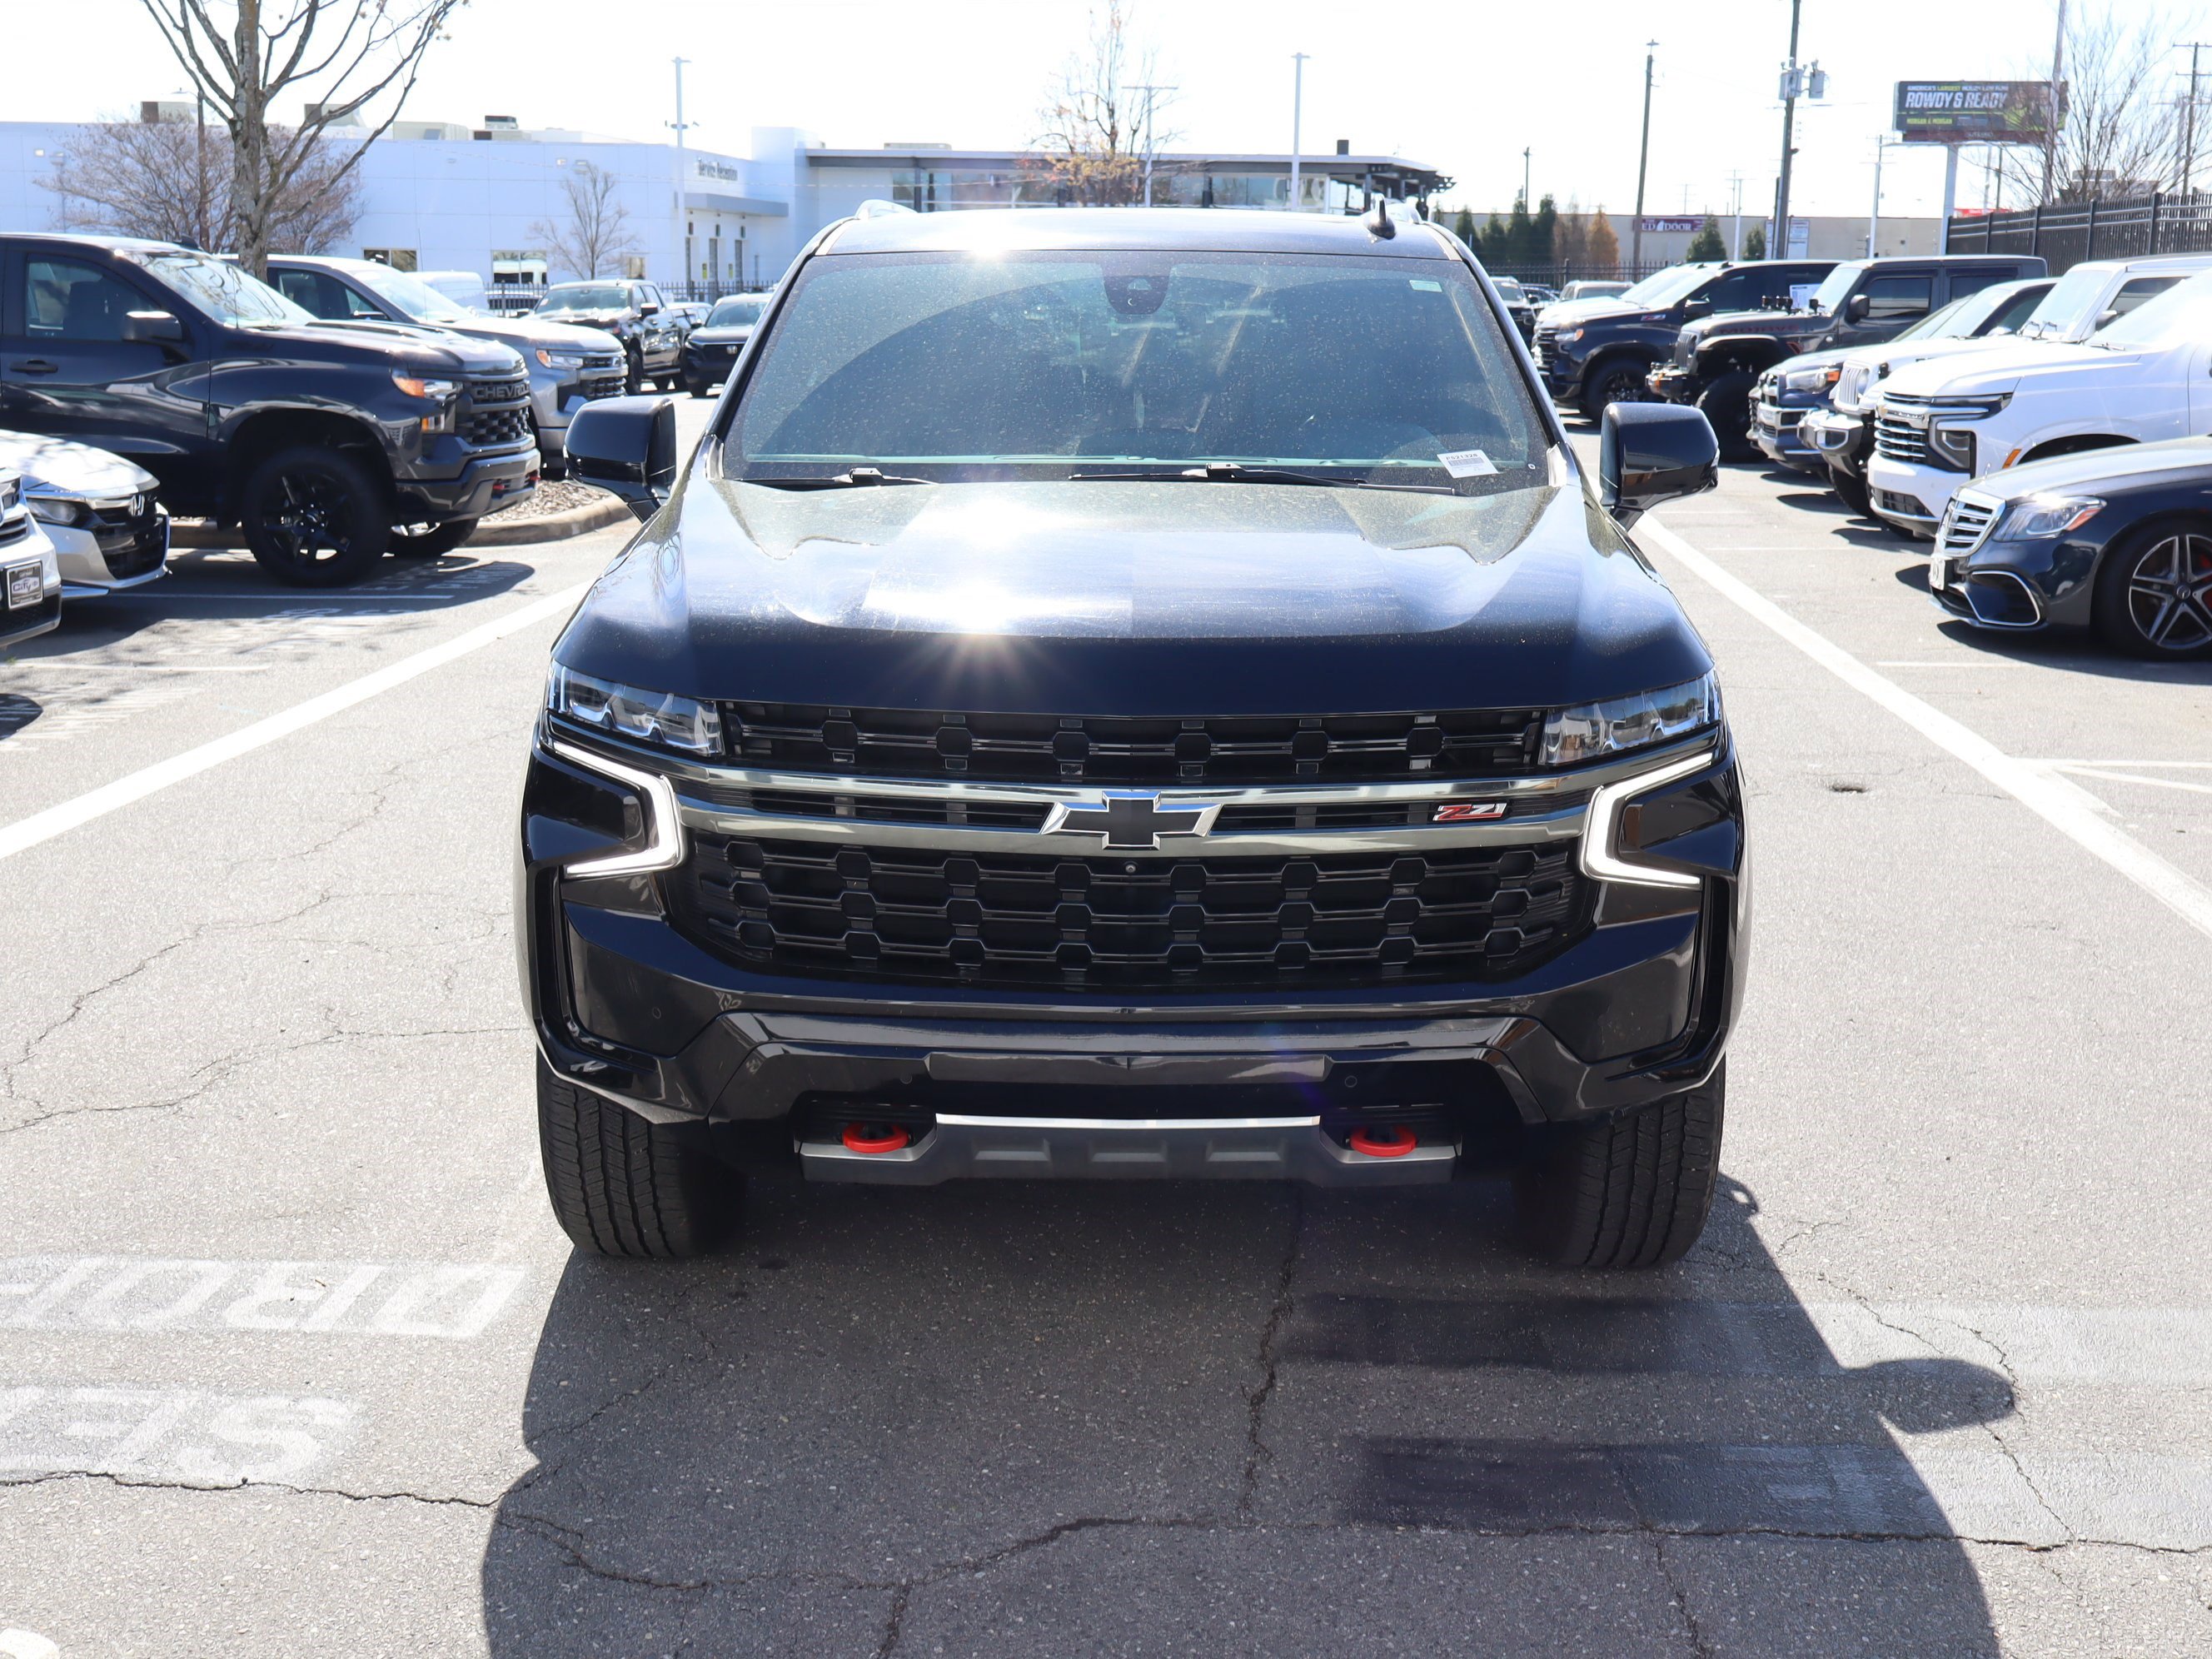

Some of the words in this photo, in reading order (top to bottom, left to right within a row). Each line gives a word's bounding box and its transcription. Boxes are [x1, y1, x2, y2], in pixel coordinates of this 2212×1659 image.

[1906, 92, 1953, 108] ROWDY
[1965, 92, 2008, 108] READY
[1640, 222, 1655, 231] ED
[1665, 222, 1692, 231] DOOR
[1432, 803, 1507, 820] Z71
